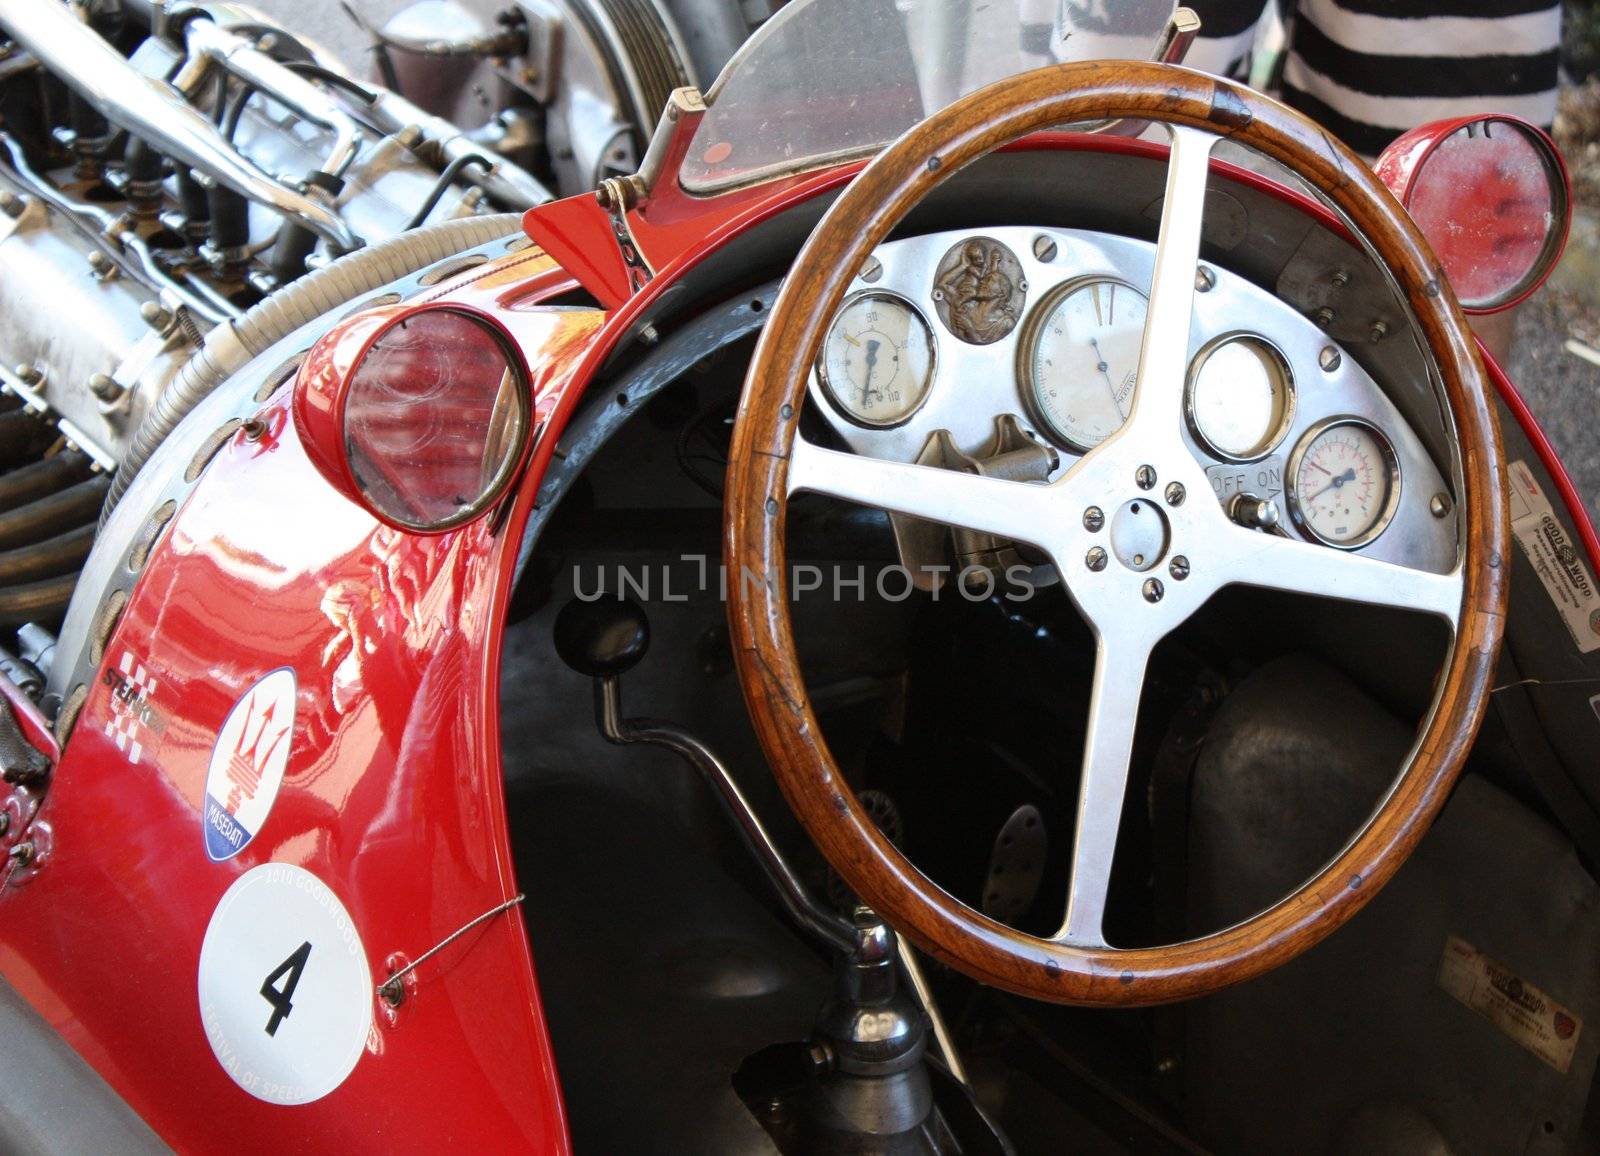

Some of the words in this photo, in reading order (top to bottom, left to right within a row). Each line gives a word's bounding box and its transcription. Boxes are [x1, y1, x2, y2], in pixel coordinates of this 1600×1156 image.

[1211, 474, 1246, 493] OFF
[1257, 468, 1281, 488] ON
[1541, 515, 1565, 545] GOOD
[1569, 564, 1592, 598] WOOD
[207, 804, 243, 849] MASERATI
[296, 869, 359, 956] GOODWOOD
[259, 940, 313, 1038] 4
[204, 1002, 241, 1077] FESTIVAL
[241, 1071, 258, 1088] OF
[261, 1081, 305, 1101] SPEED
